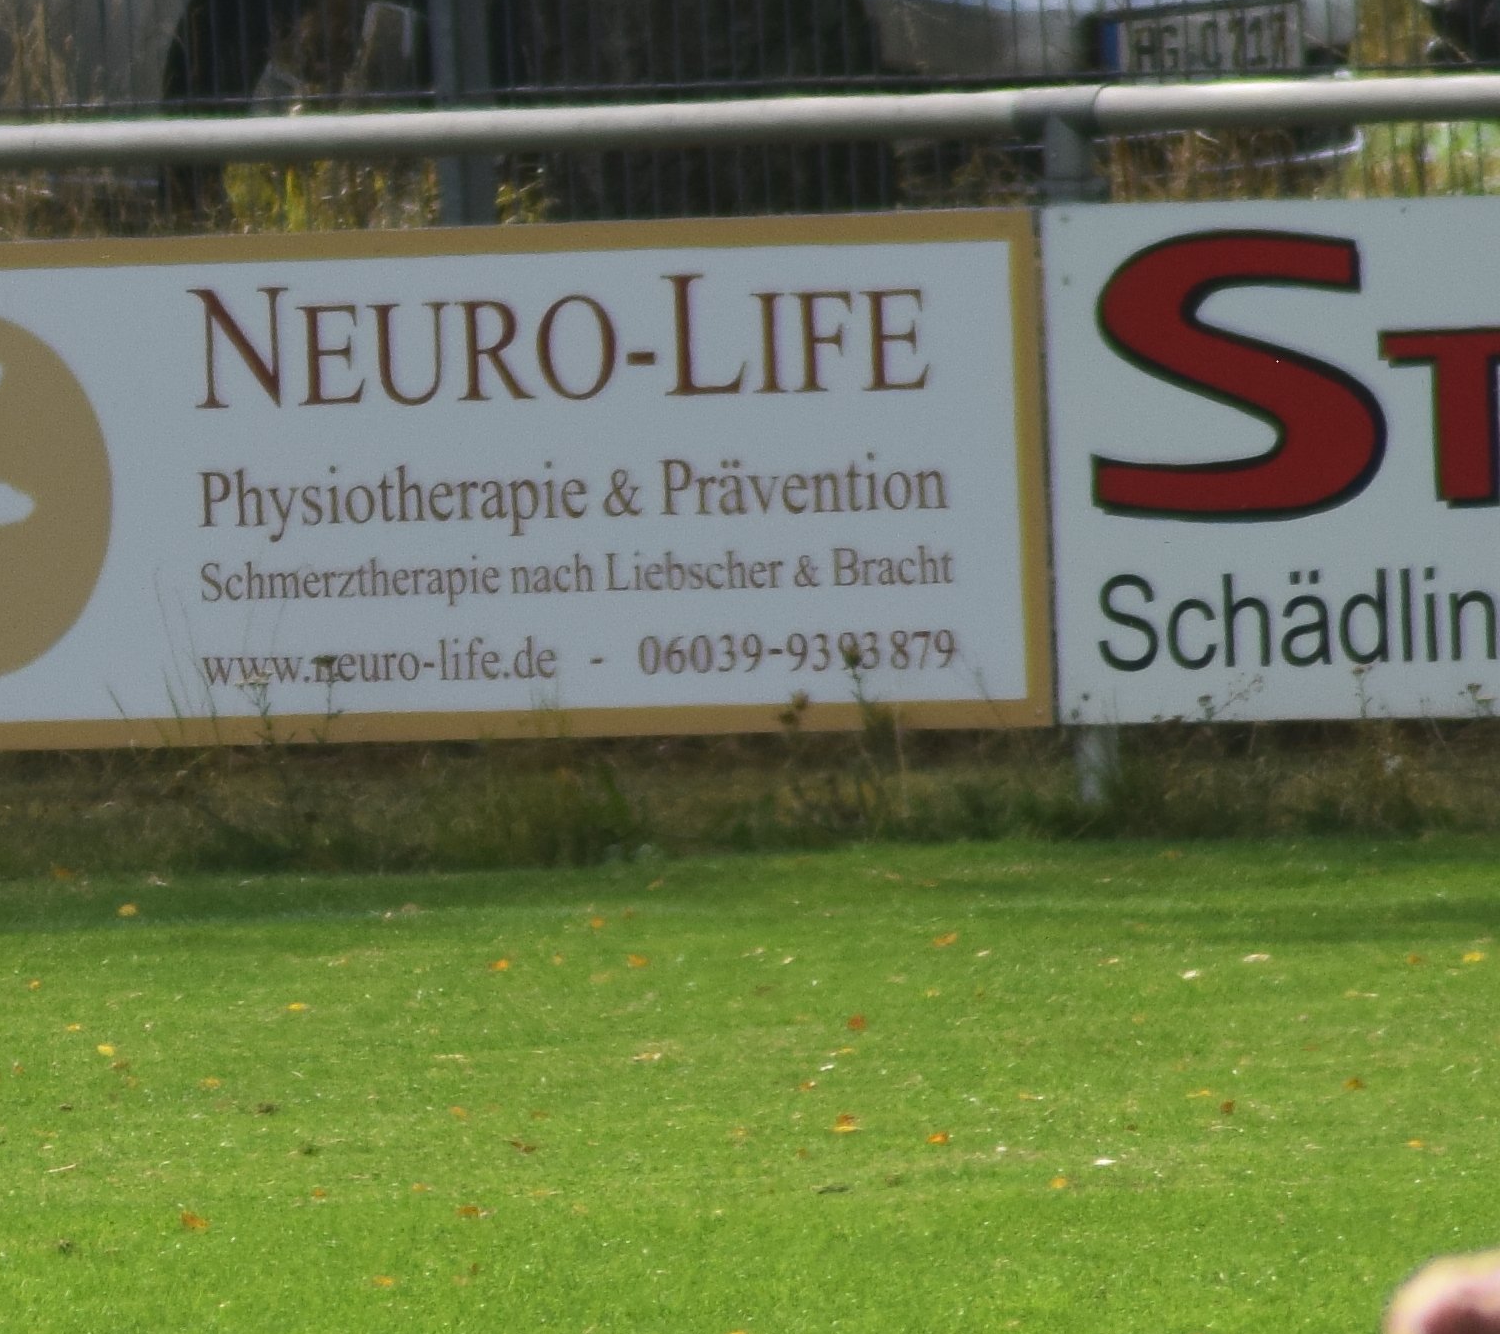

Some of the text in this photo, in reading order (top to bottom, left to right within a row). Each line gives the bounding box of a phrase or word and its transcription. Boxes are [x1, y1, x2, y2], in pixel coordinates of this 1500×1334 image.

[186, 273, 930, 409] NEURO-LIFE
[199, 452, 948, 542] Physiotherapie & Prävention
[200, 545, 955, 605] Schmerztherapie nach Liebscher & Bracht
[201, 635, 558, 687] www.neuro-life.de
[639, 629, 956, 675] 06039-9393879
